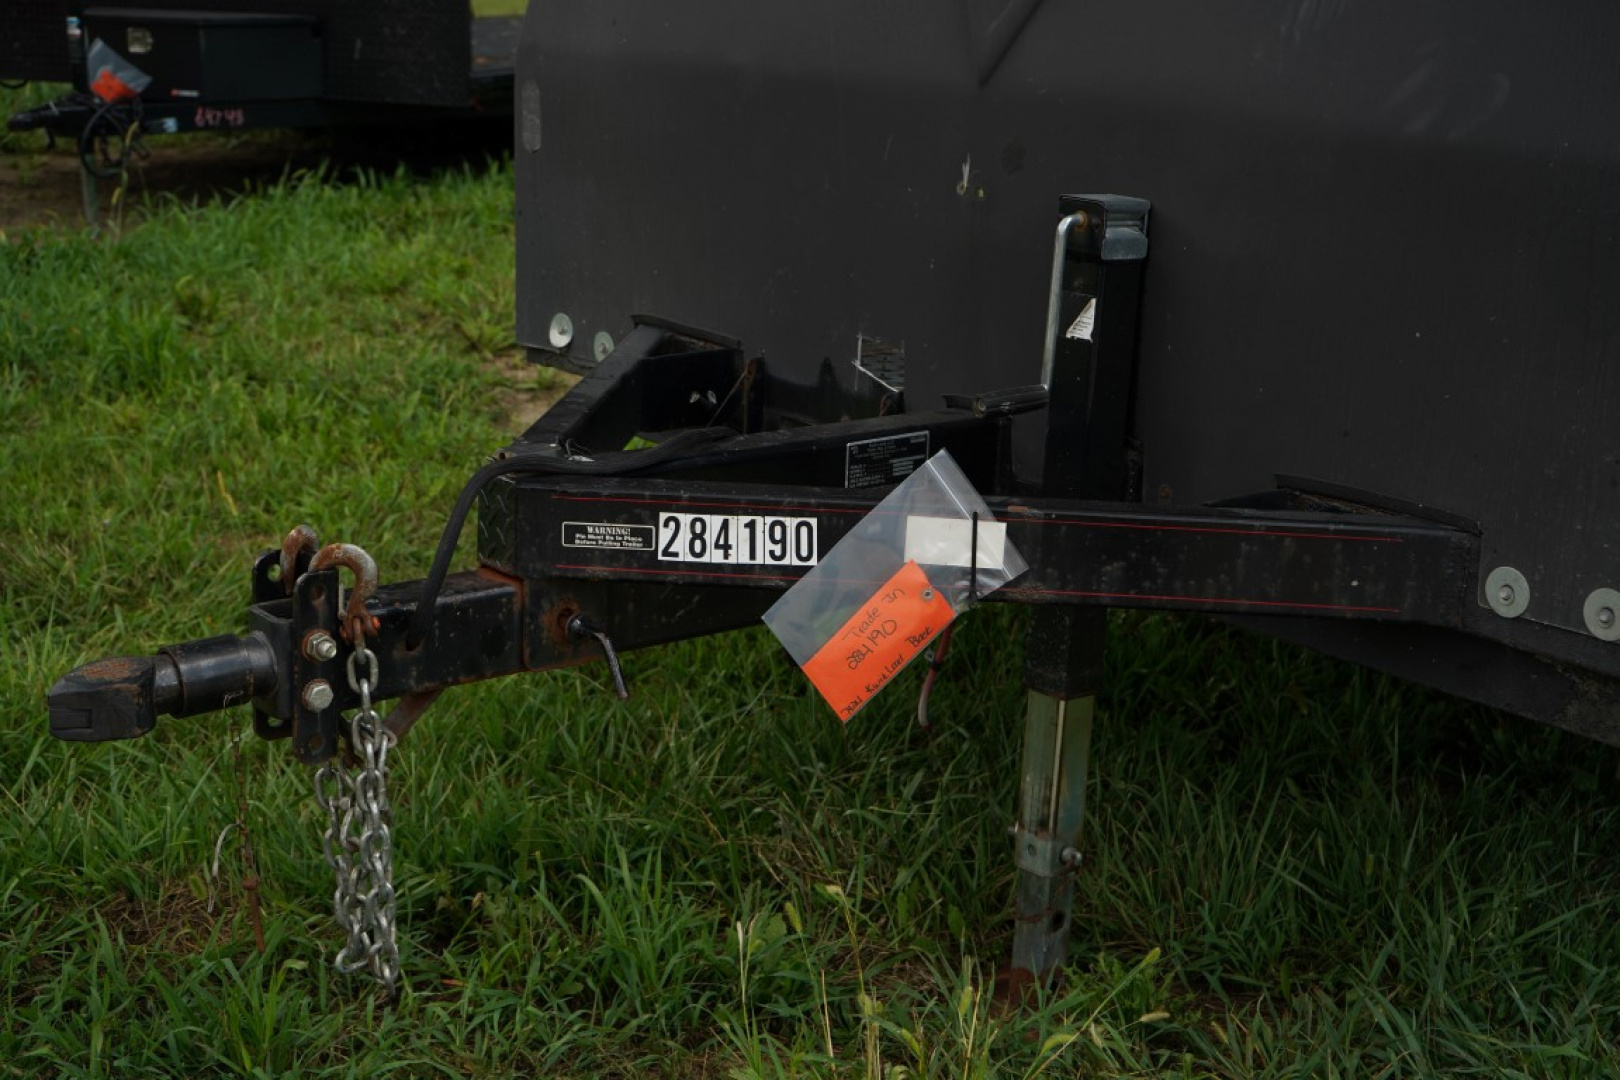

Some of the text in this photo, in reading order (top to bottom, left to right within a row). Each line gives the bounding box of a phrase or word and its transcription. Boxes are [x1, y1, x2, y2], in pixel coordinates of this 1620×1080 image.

[587, 526, 631, 535] WARNING!
[660, 515, 815, 563] 284190
[842, 607, 880, 640] Trade
[846, 619, 898, 670] 284190
